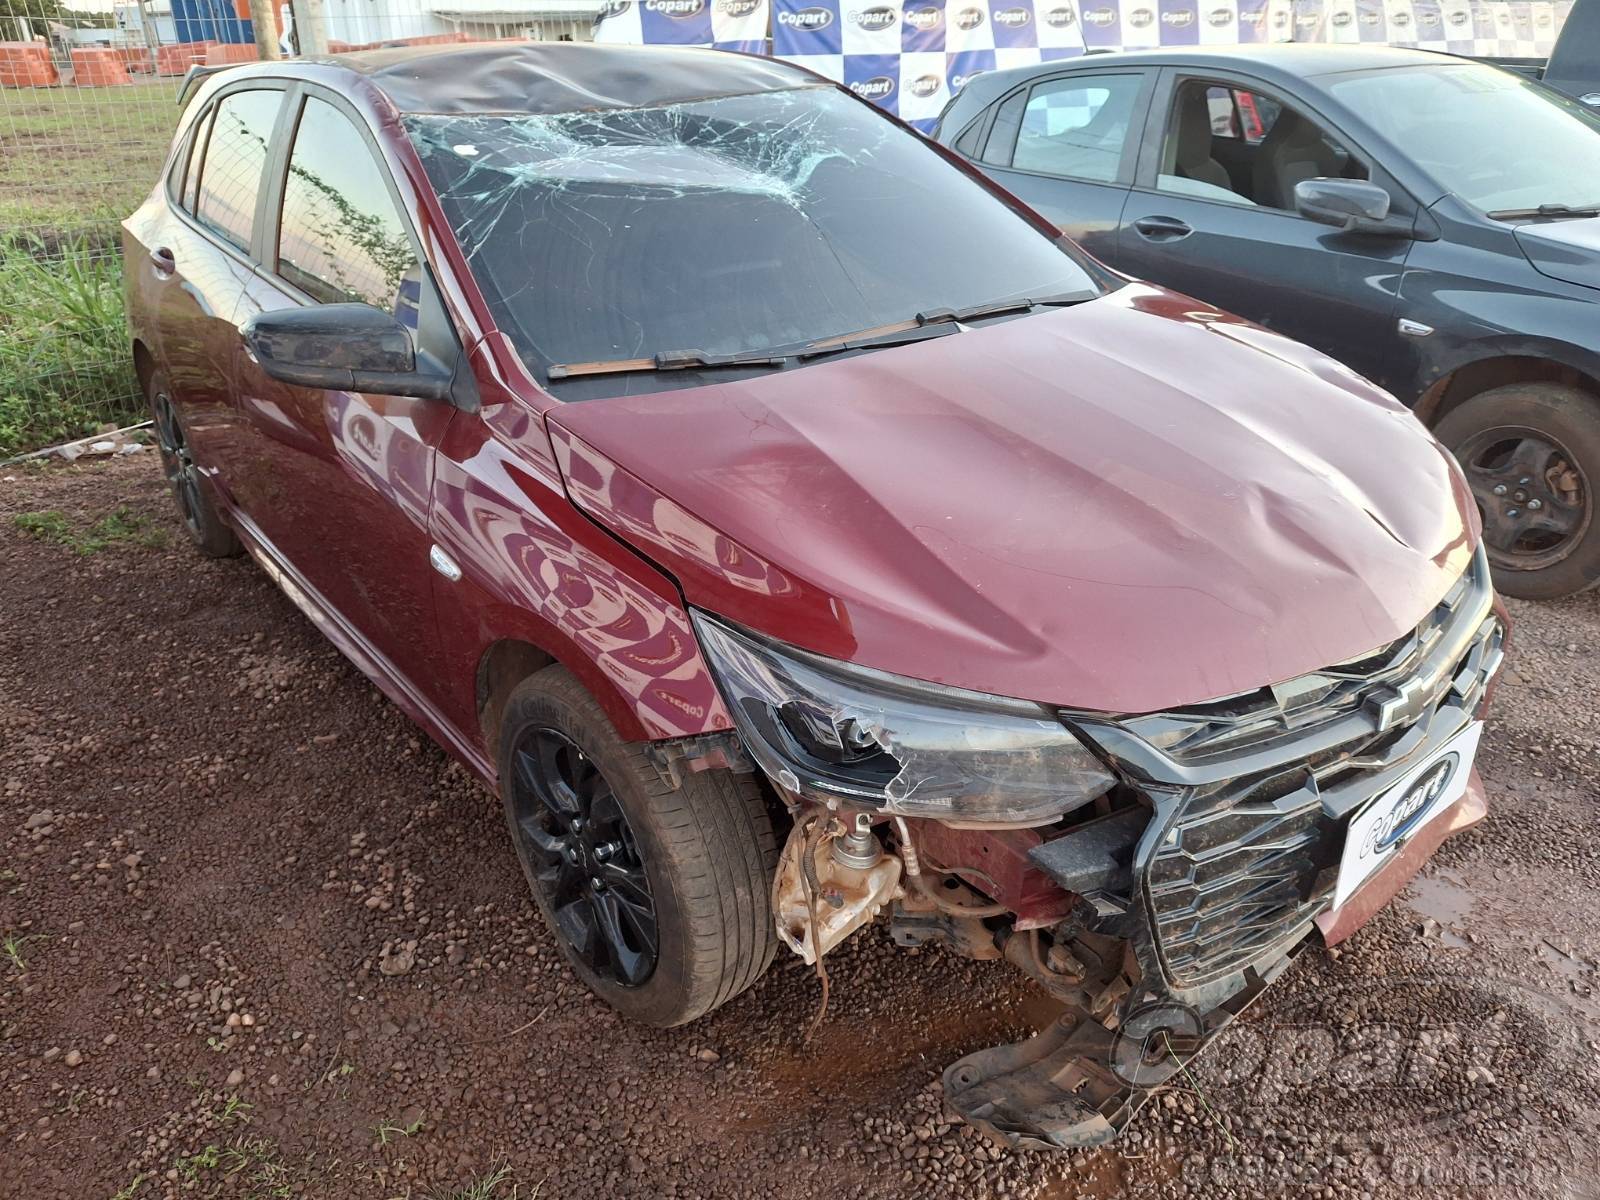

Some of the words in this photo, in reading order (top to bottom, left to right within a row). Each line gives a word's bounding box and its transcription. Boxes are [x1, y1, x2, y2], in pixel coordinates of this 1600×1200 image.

[645, 0, 699, 12] Copart
[777, 10, 827, 26] Copart
[847, 10, 893, 24] Copart
[905, 10, 938, 24] Copart
[993, 10, 1029, 24] Copart
[1083, 10, 1113, 23] Copart
[1161, 12, 1191, 24] Copart
[848, 80, 890, 97] Copart
[1359, 760, 1451, 860] Copart
